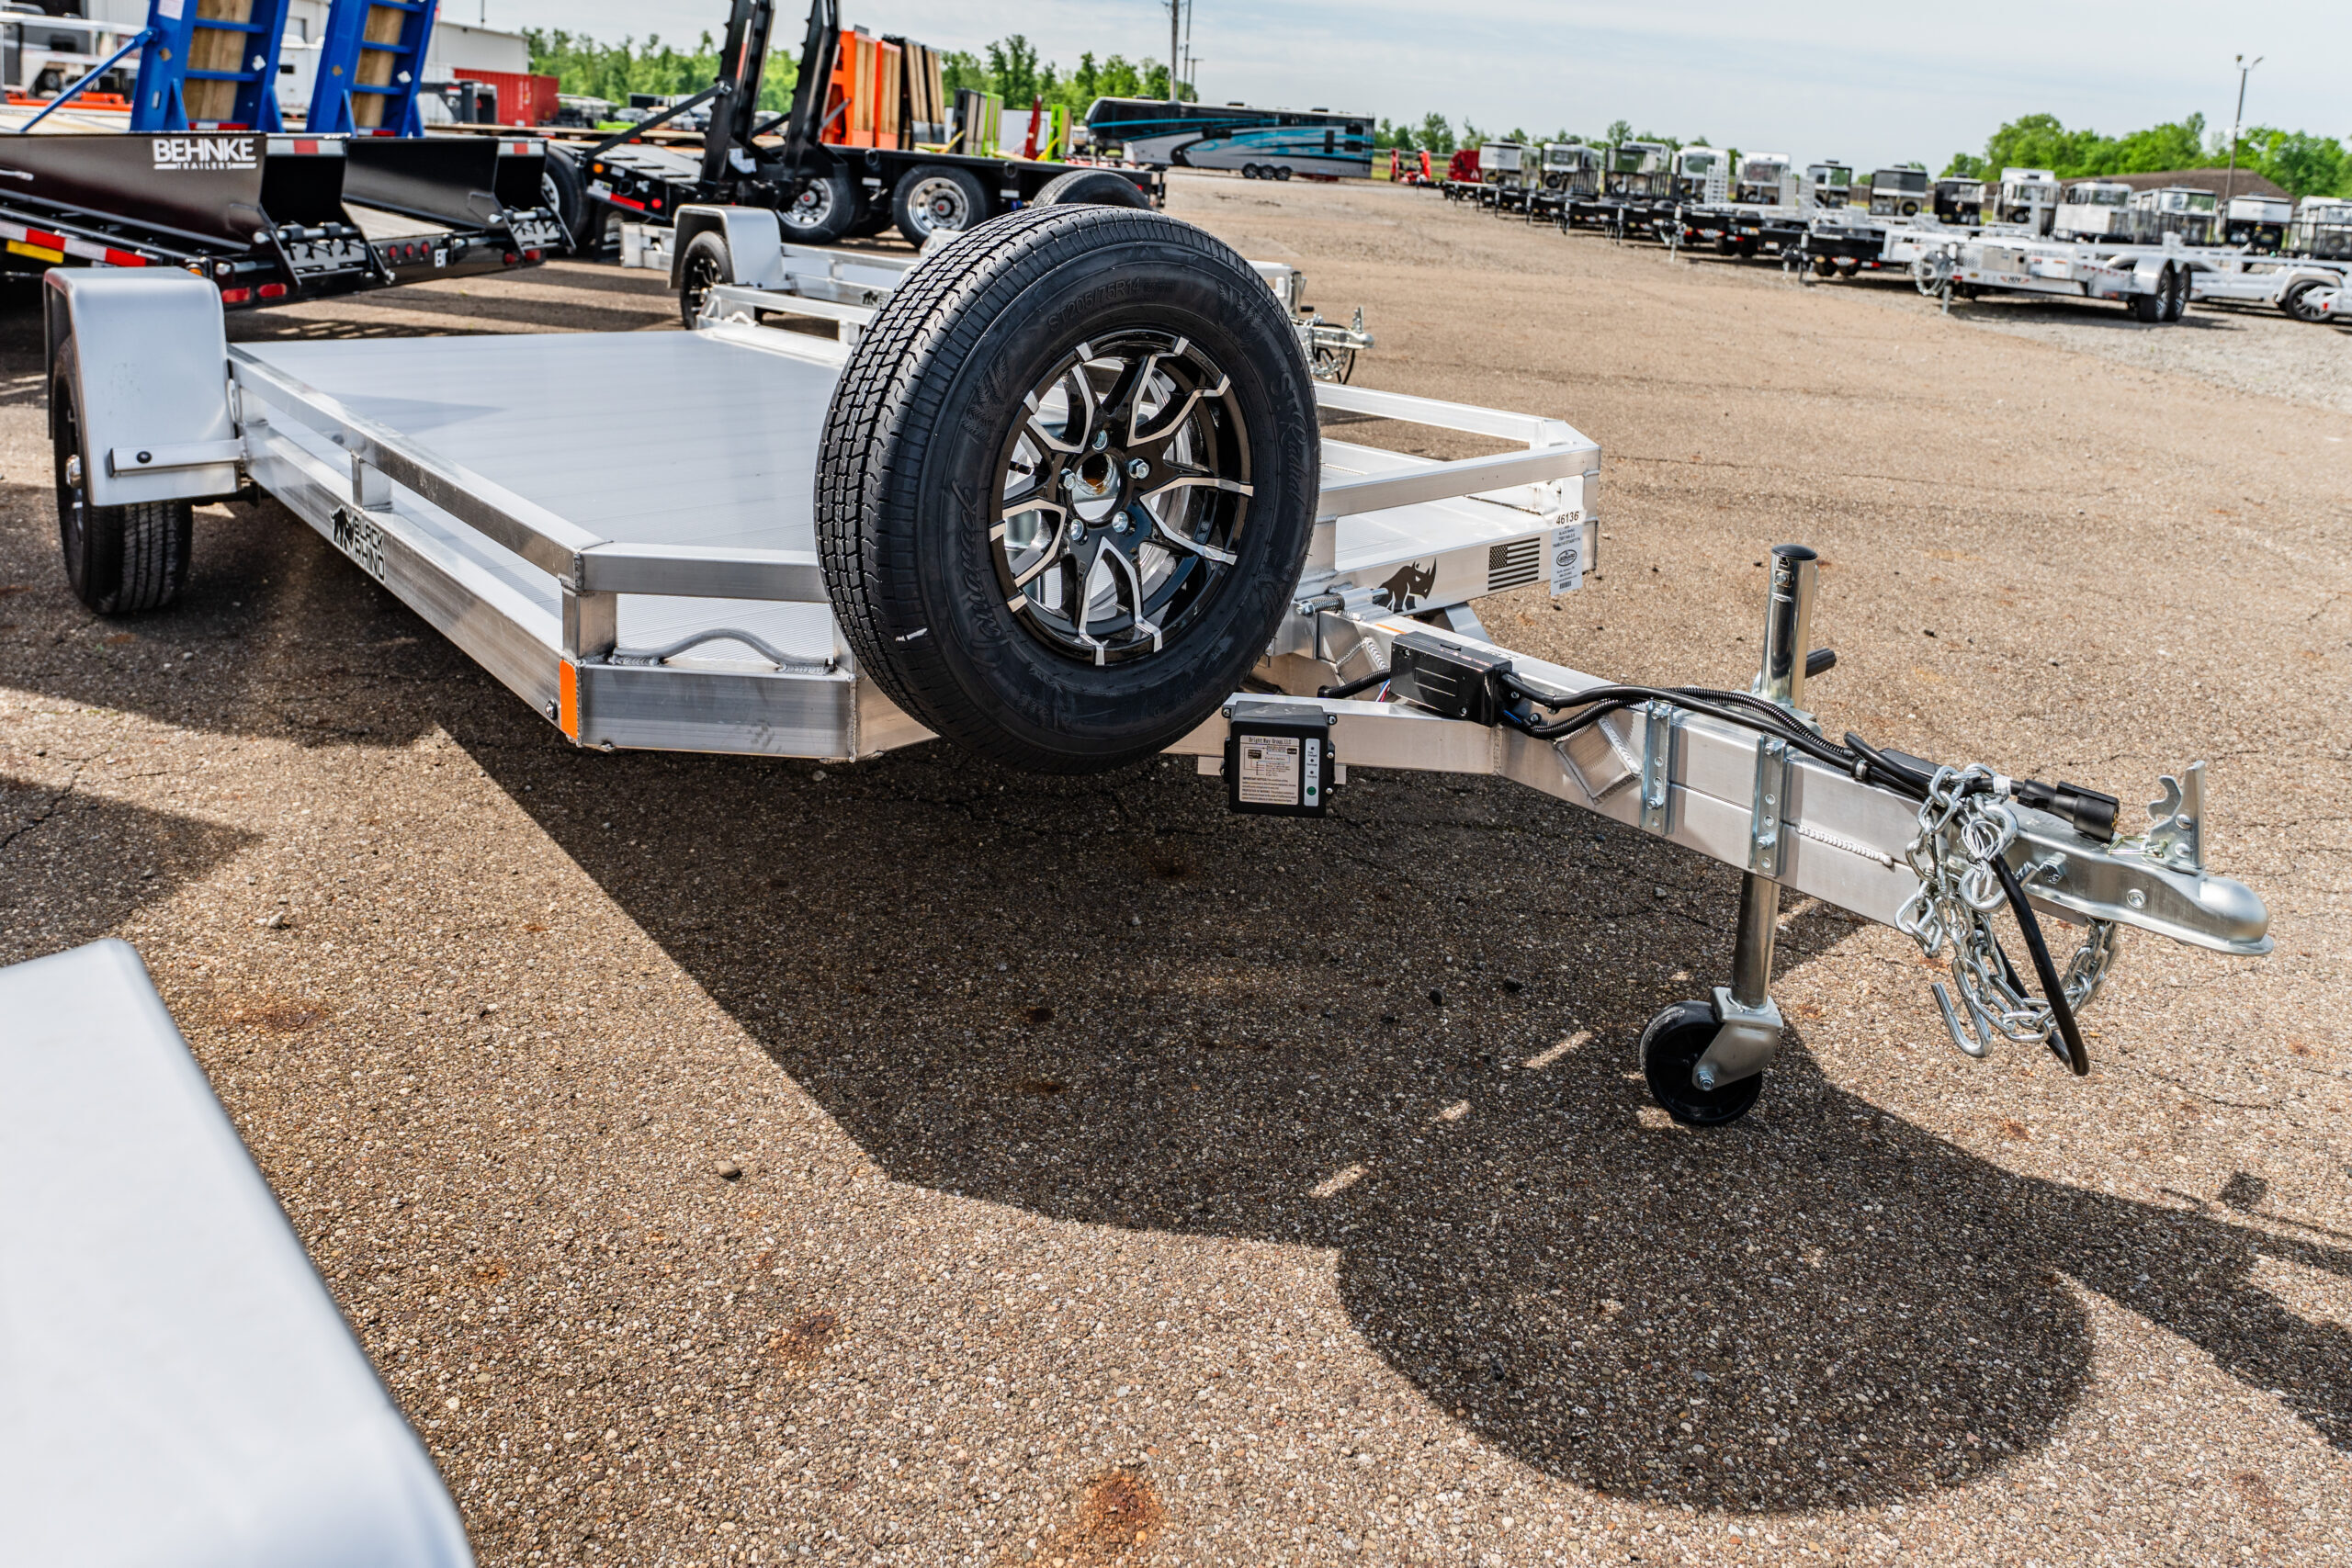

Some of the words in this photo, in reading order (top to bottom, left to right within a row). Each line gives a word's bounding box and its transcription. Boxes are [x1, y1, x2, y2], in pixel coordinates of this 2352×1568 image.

[152, 138, 257, 162] BEHNKE
[176, 162, 233, 170] TRAILERS
[1555, 511, 1579, 525] 46136
[354, 515, 384, 555] BLACK
[355, 536, 385, 581] RHINO
